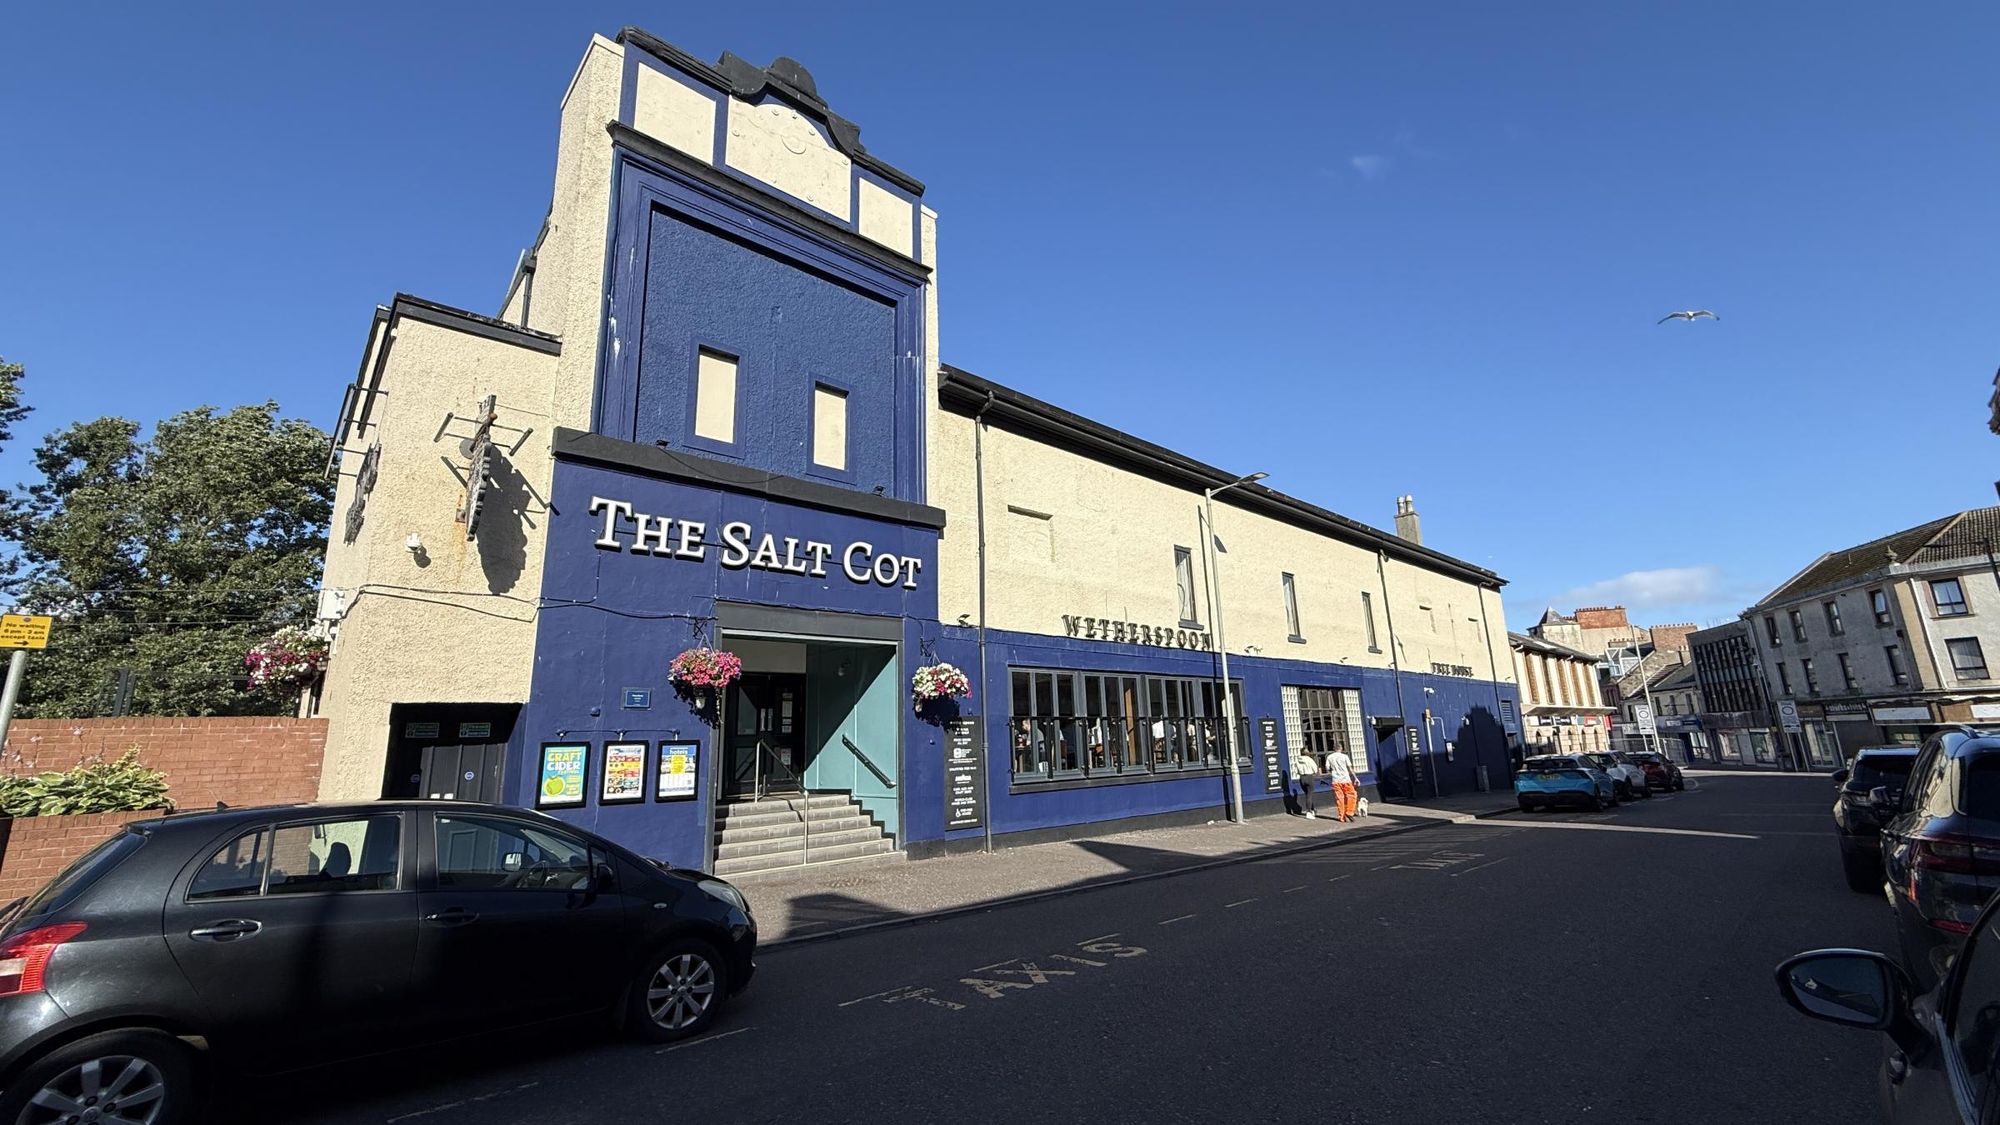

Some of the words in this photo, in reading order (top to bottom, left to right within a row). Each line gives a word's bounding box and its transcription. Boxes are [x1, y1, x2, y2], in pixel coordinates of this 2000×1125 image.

[589, 496, 706, 562] THE
[721, 521, 832, 577] SALT
[843, 541, 921, 588] COT
[1061, 614, 1211, 650] WETHERSPOON
[547, 761, 581, 771] CIDER
[548, 752, 582, 761] CRAFT
[882, 942, 1148, 1011] TAXIS
